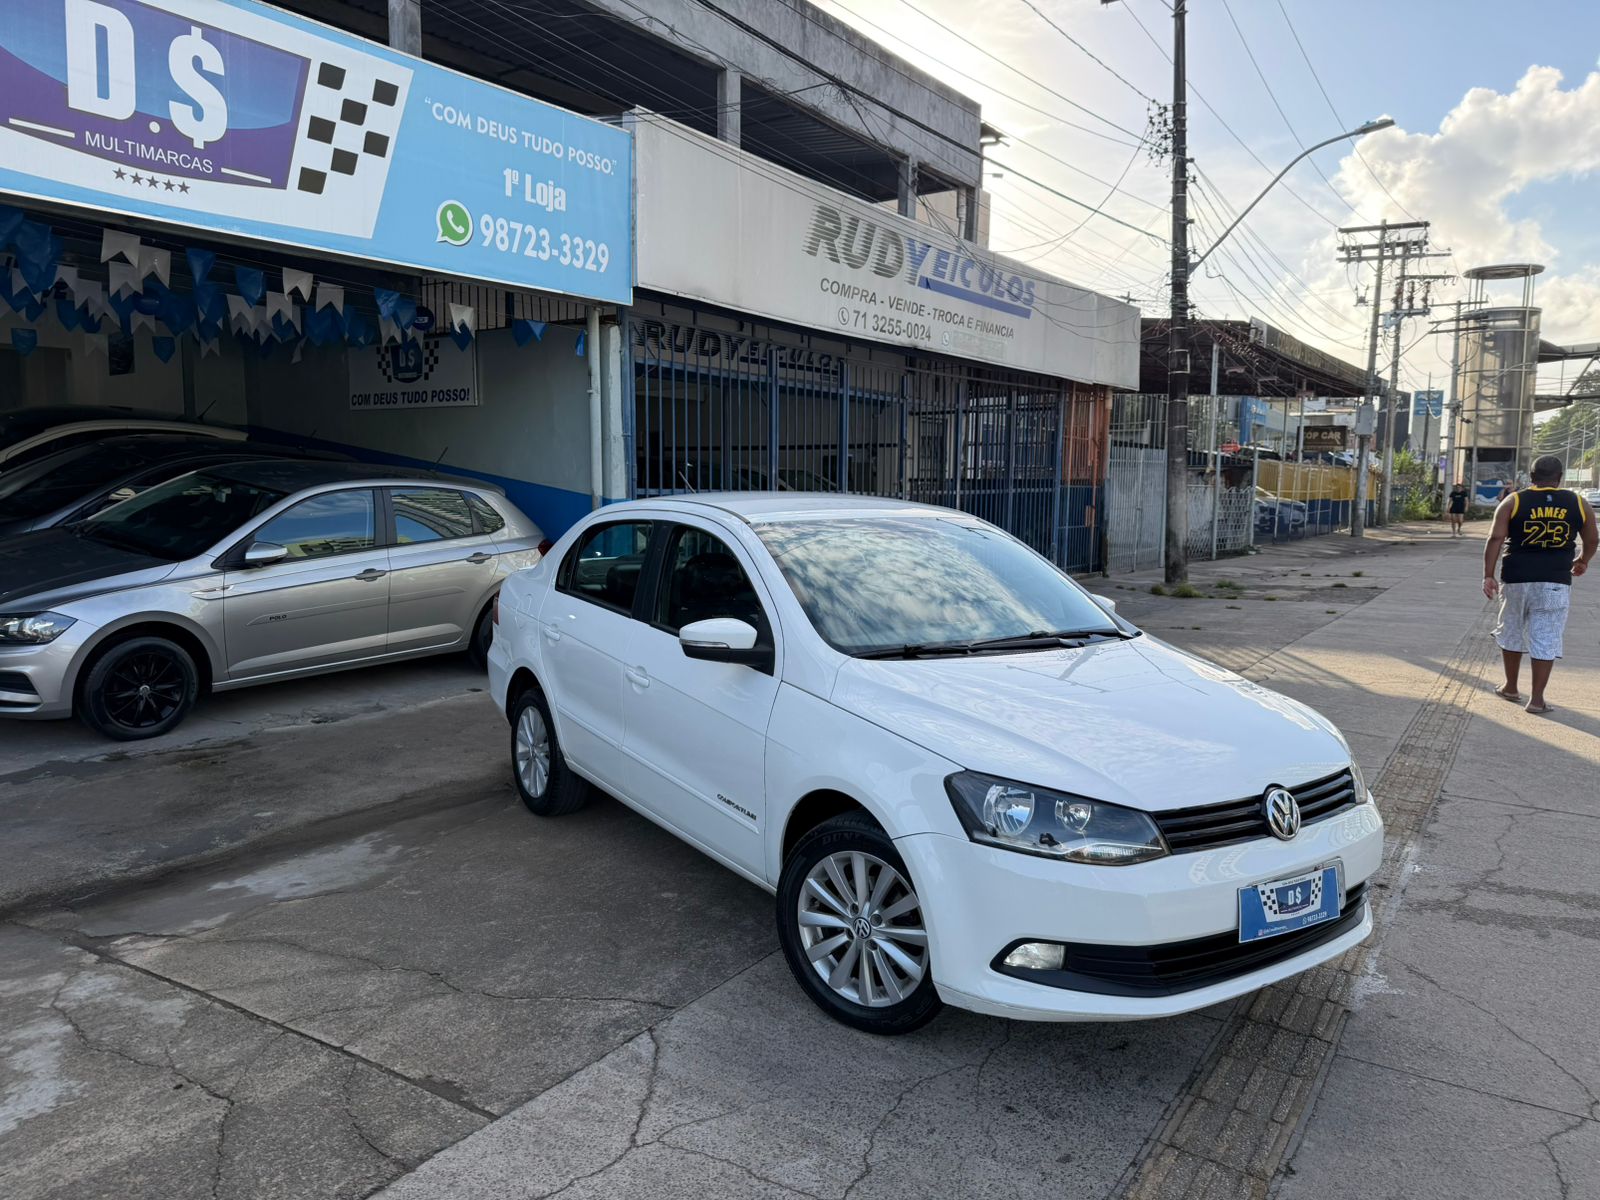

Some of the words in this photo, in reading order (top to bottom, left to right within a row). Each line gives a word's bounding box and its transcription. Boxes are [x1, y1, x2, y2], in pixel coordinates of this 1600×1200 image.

[85, 130, 213, 174] MULTIMARCAS
[476, 116, 518, 145] DEUS
[521, 131, 564, 159] TUDO
[524, 173, 567, 213] Loja
[479, 213, 609, 273] 98723-3329
[820, 277, 877, 304] COMPRA
[888, 296, 925, 318] VENDE
[932, 308, 965, 328] TROCA
[967, 317, 974, 329] E
[974, 320, 1015, 339] FINANCIA
[853, 310, 868, 330] 71
[872, 314, 931, 343] 3255-0024
[351, 393, 371, 406] COM
[373, 391, 398, 406] DEUS
[401, 390, 428, 404] TUDO
[431, 387, 470, 403] POSSO!
[1303, 431, 1319, 440] OP
[1321, 430, 1342, 443] CAR
[1530, 506, 1568, 519] JAMES
[1521, 520, 1570, 548] 23
